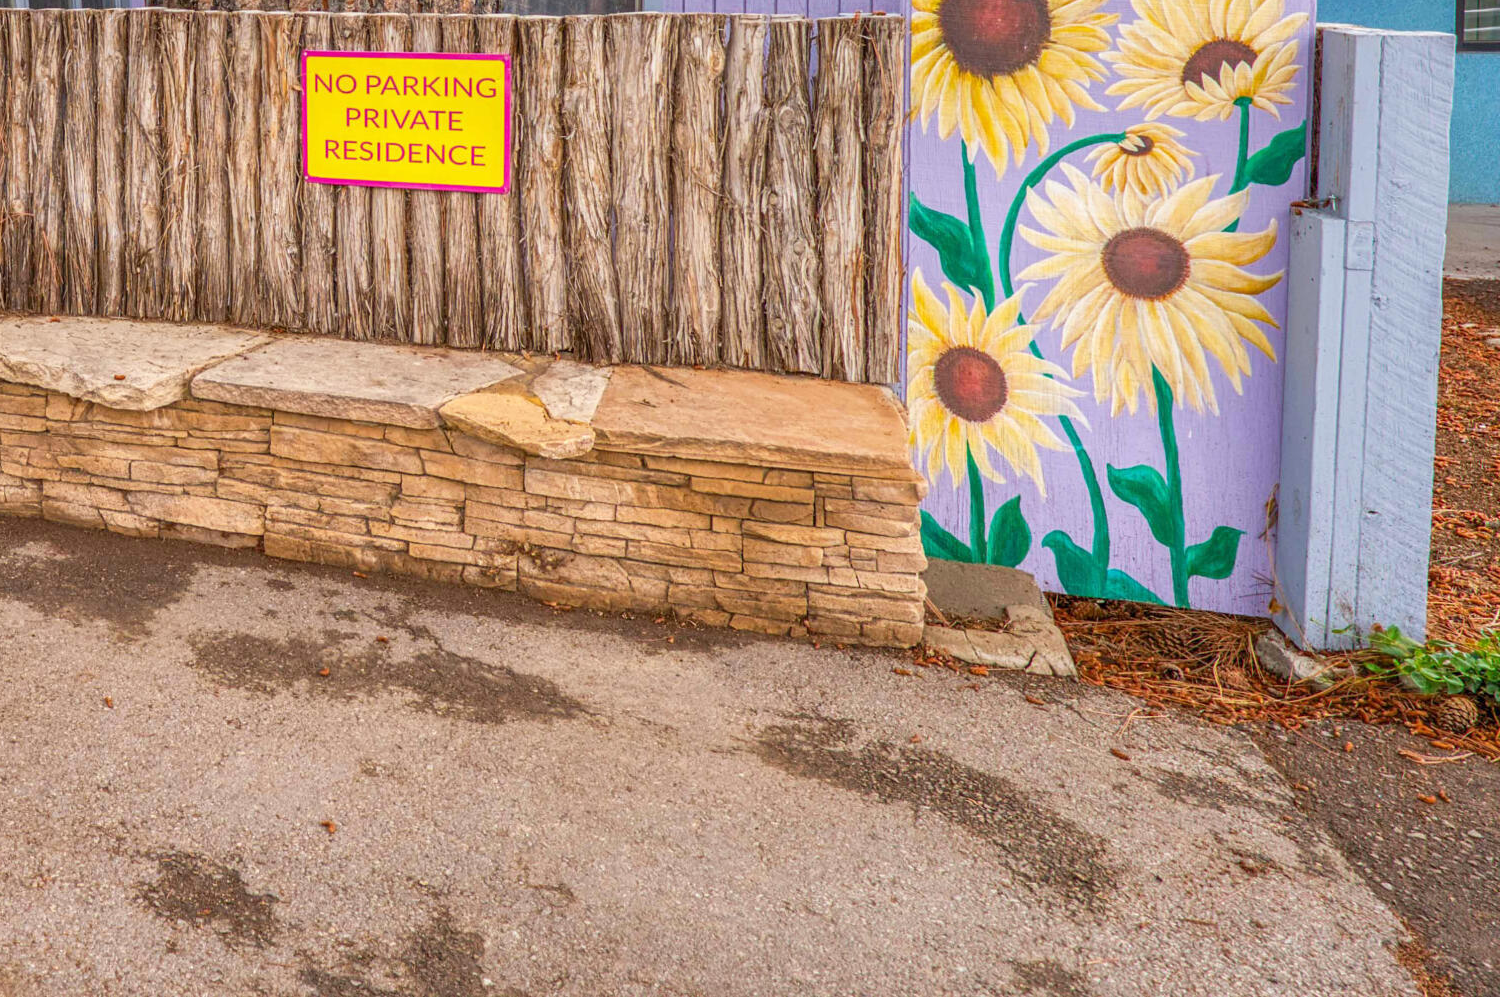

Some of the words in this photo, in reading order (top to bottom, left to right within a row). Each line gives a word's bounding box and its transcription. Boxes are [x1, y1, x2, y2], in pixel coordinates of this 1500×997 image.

[314, 73, 357, 94] NO
[366, 75, 497, 99] PARKING
[346, 107, 464, 132] PRIVATE
[325, 139, 486, 167] RESIDENCE
